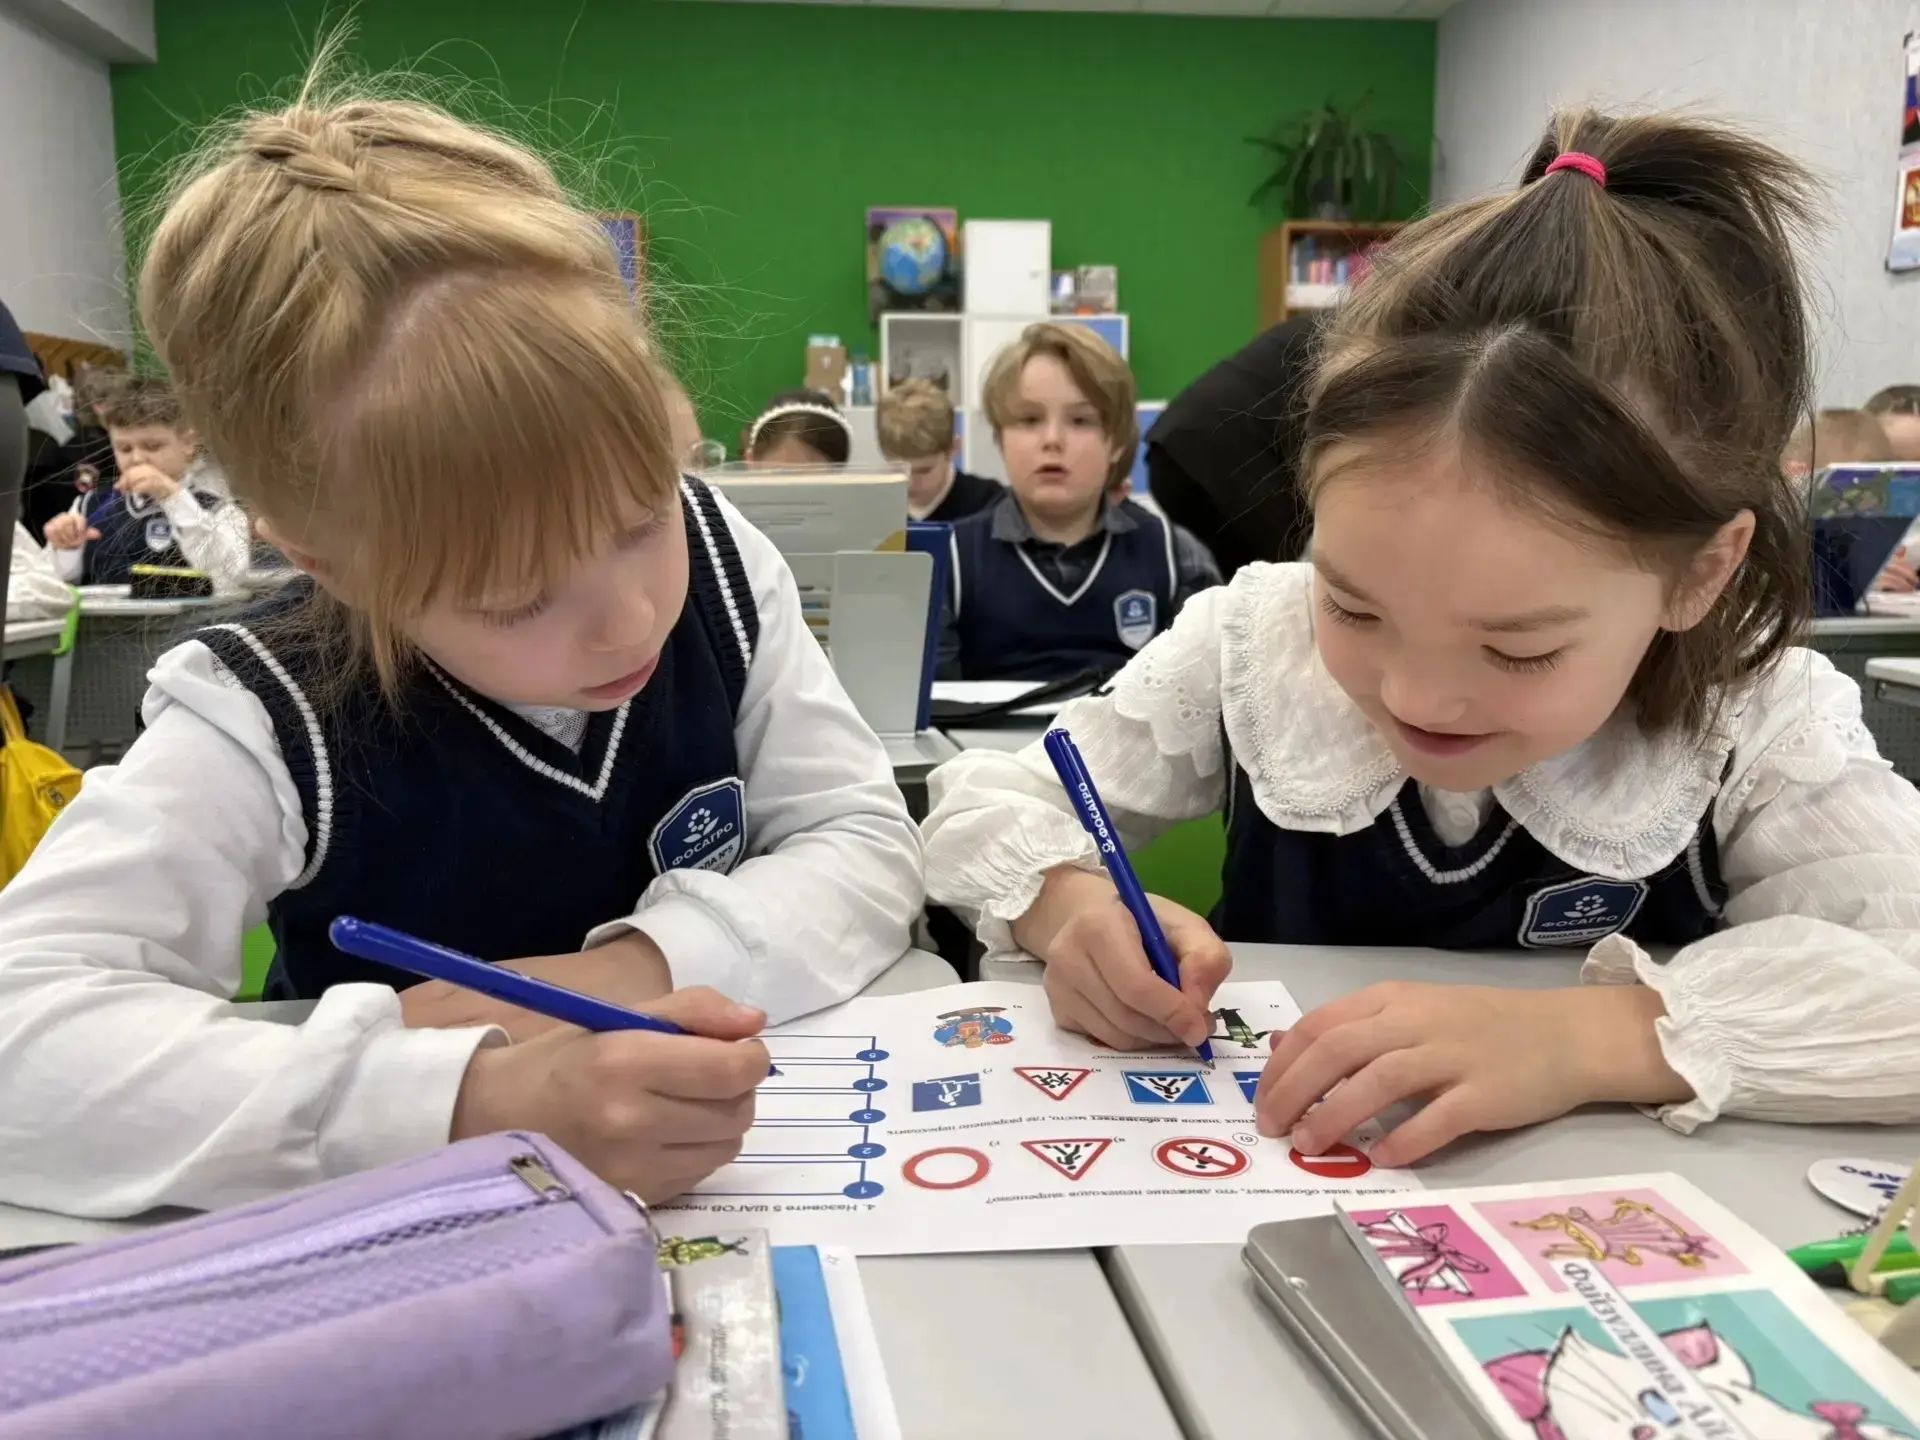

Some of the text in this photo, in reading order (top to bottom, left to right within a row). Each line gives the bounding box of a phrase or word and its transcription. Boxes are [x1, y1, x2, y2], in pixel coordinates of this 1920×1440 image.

[1079, 782, 1108, 838] ФОСАГРО
[672, 822, 734, 866] ФОСАГРО
[1541, 915, 1618, 927] ФОСАГРО
[862, 1112, 872, 1120] 3
[862, 1146, 872, 1154] 2
[711, 1204, 769, 1212] ШАГОВ
[772, 1204, 782, 1212] 5
[785, 1204, 857, 1212] Назовите
